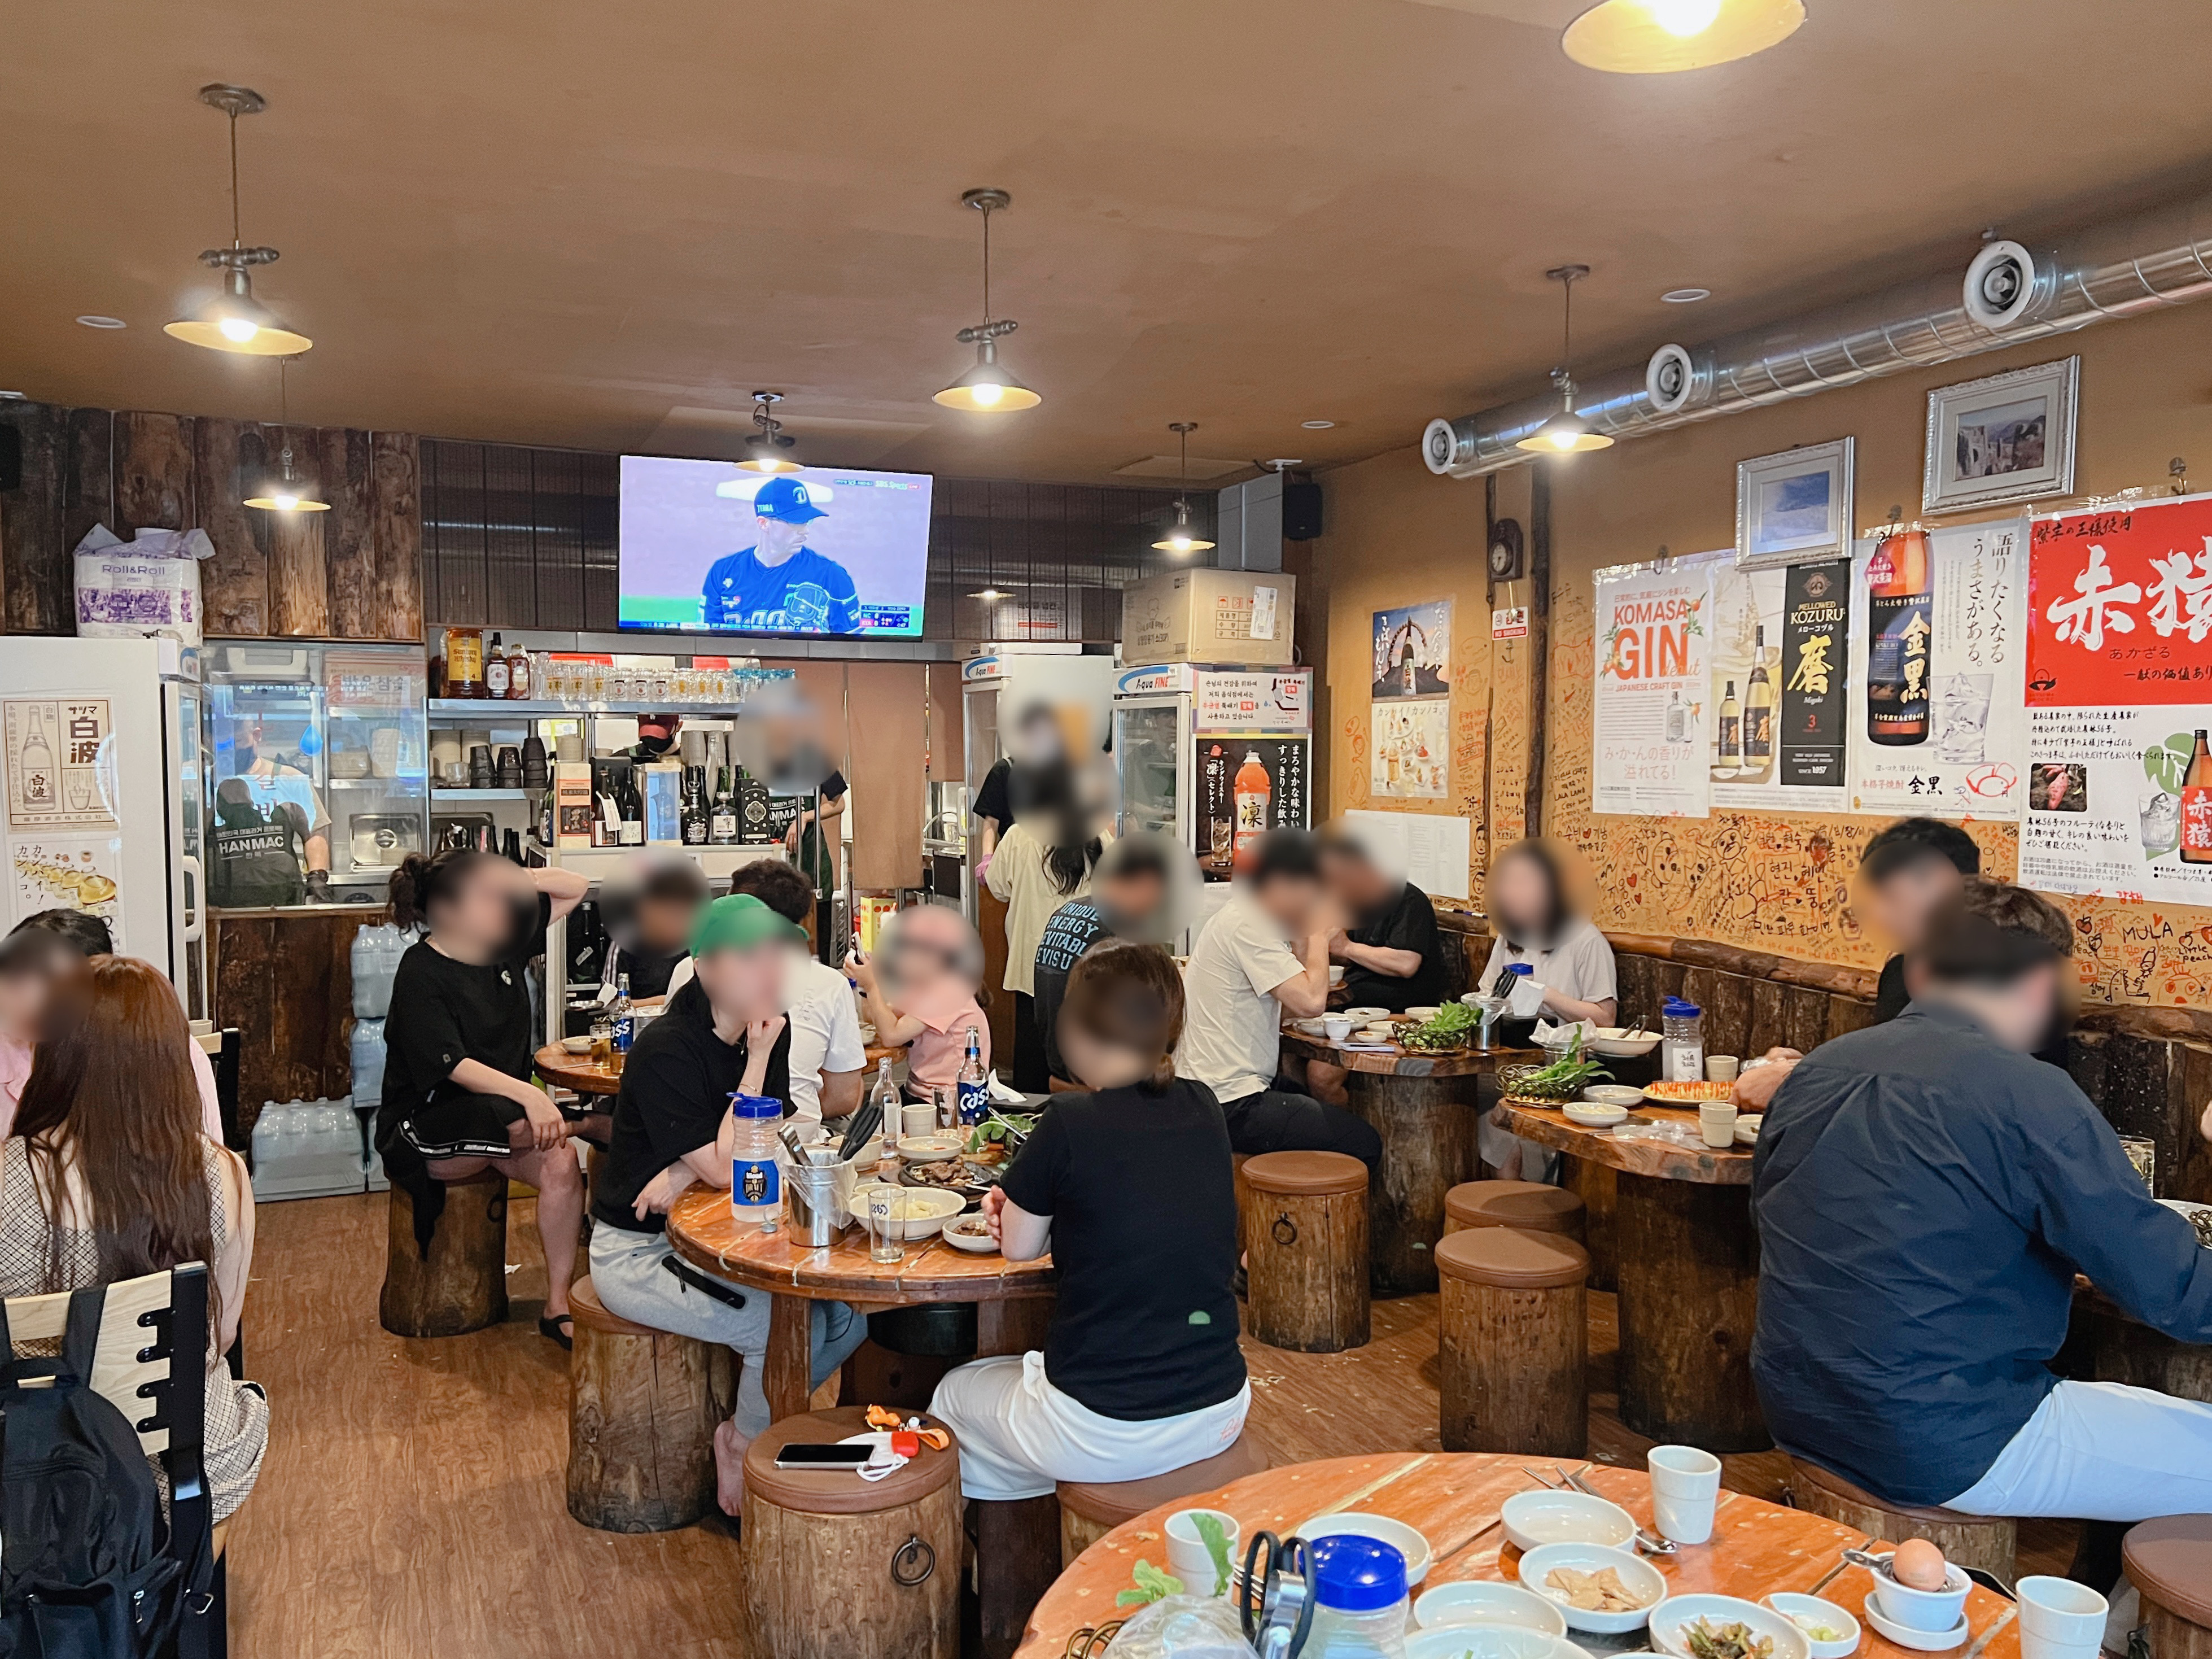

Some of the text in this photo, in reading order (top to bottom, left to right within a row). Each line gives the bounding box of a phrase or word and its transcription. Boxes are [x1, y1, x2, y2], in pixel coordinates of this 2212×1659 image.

[102, 565, 165, 575] Roll&Roll
[1967, 538, 1984, 667] うまさがある。
[1990, 532, 2013, 663] 語りたくなる
[1614, 598, 1689, 625] KOMASA
[1790, 608, 1844, 625] KOZURU
[1614, 622, 1689, 680] GIN
[2109, 645, 2171, 660] あかざる
[1136, 677, 1169, 690] Aqua FINE
[1616, 681, 1683, 692] JAPANESE CRAFT GIN
[68, 706, 98, 715] サツマ
[1808, 714, 1817, 728] 3
[69, 716, 100, 764] 白波
[32, 774, 49, 798] 白波
[1908, 774, 1943, 796] 金黒
[218, 836, 284, 854] HANMAC
[1060, 902, 1099, 922] UNIQUE
[1047, 915, 1099, 938] ENERGY
[1035, 947, 1073, 970] EVISU
